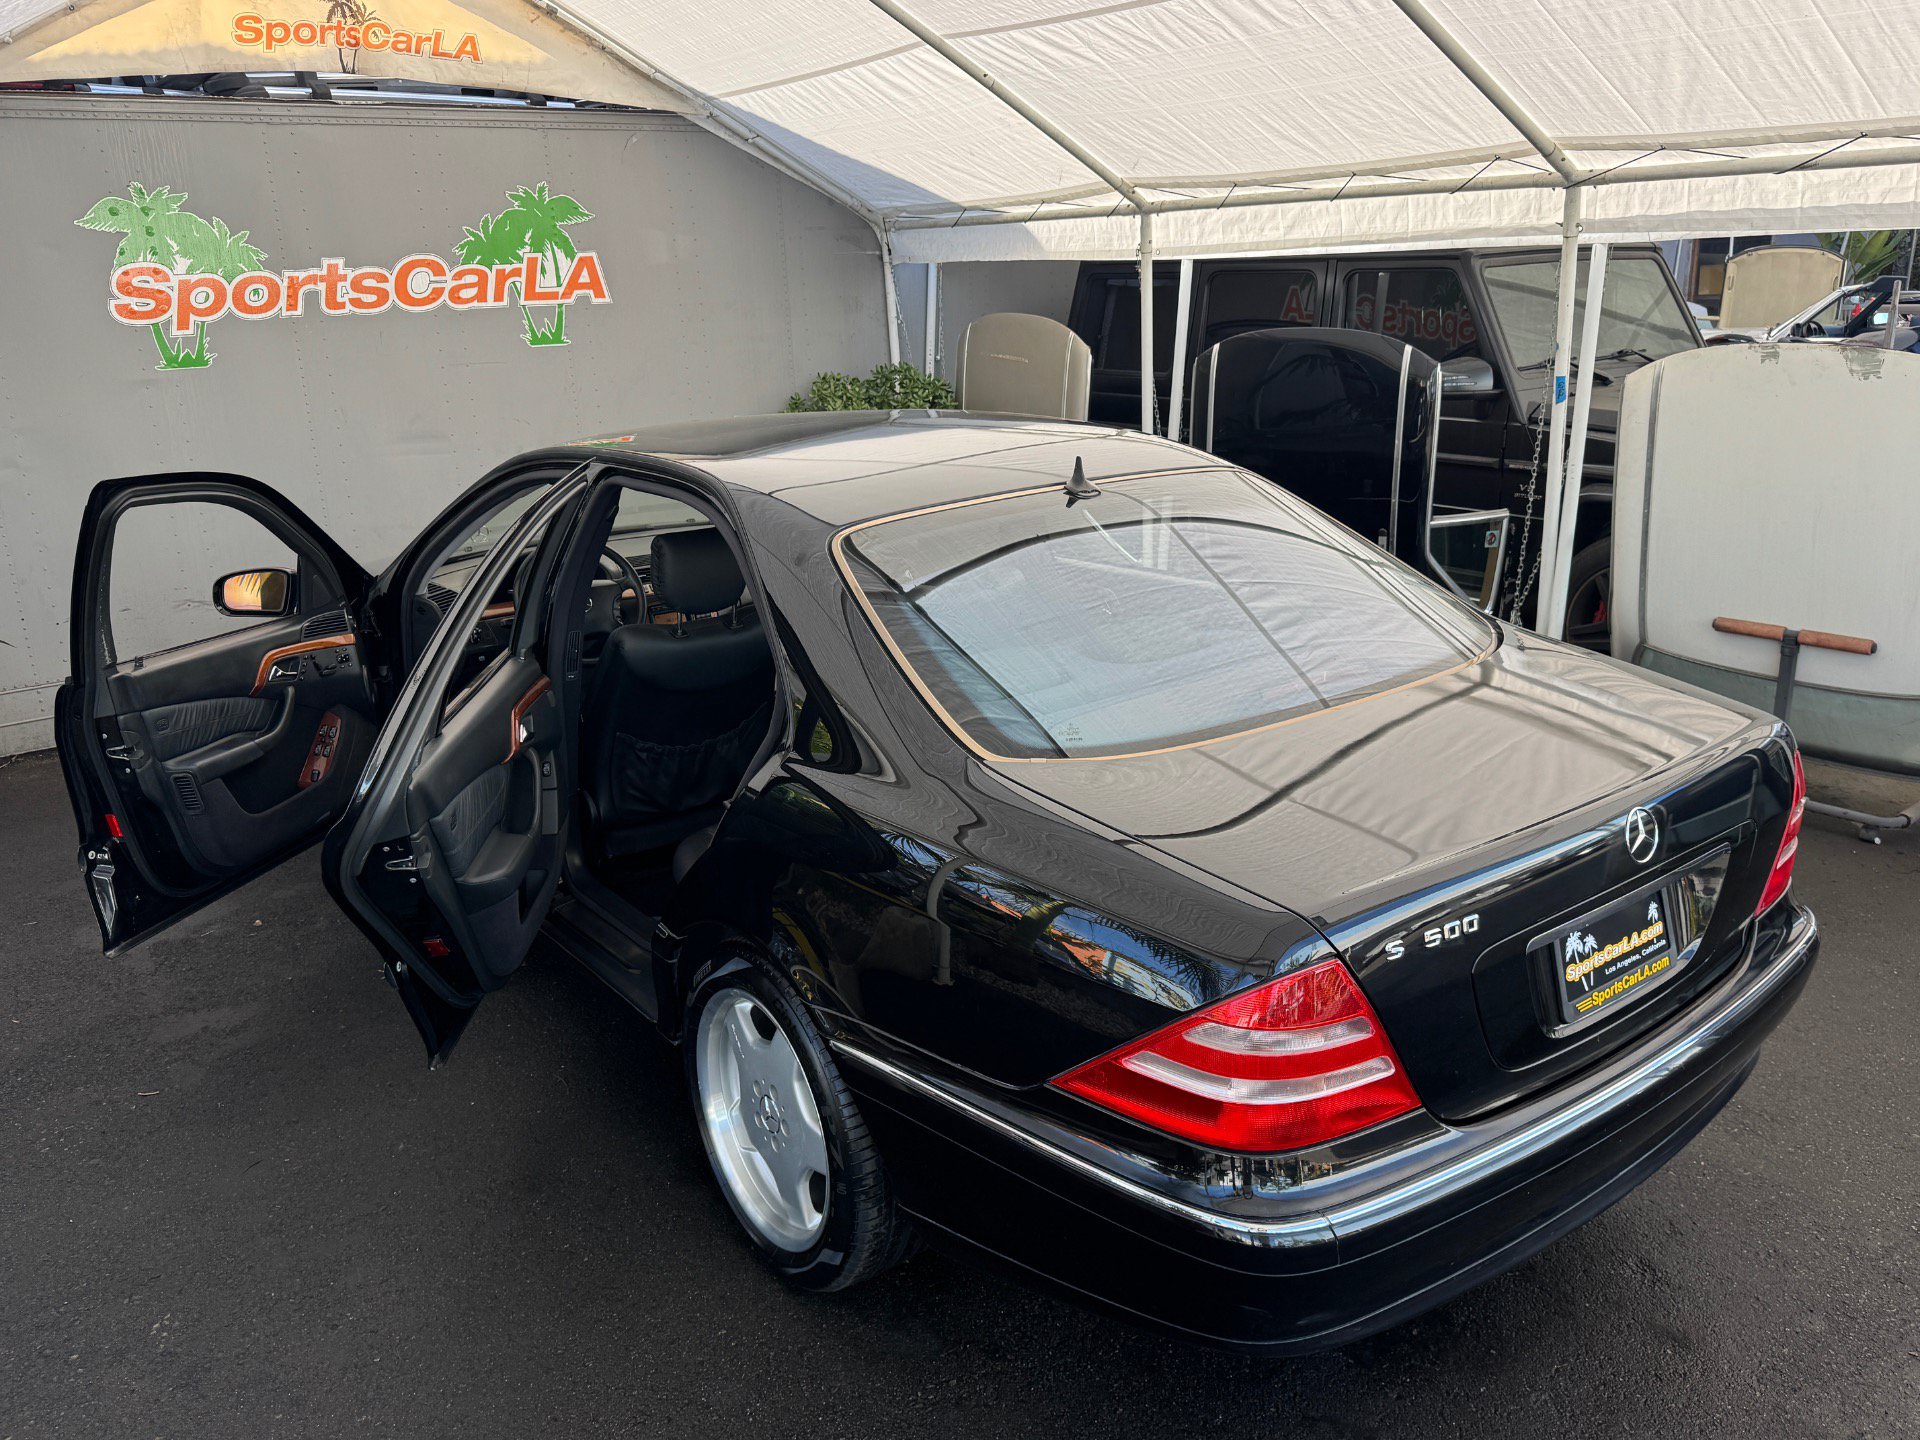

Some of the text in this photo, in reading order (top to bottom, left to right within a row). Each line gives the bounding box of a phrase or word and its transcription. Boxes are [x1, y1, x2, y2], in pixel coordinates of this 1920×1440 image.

[233, 13, 482, 63] SportsCarLA
[111, 252, 610, 334] SportsCarLA
[1385, 914, 1479, 960] S 500
[1566, 921, 1663, 981] SportsCarLA.com
[1605, 939, 1666, 975] Los Angeles, California
[1592, 956, 1670, 1006] SportsCarLA.com
